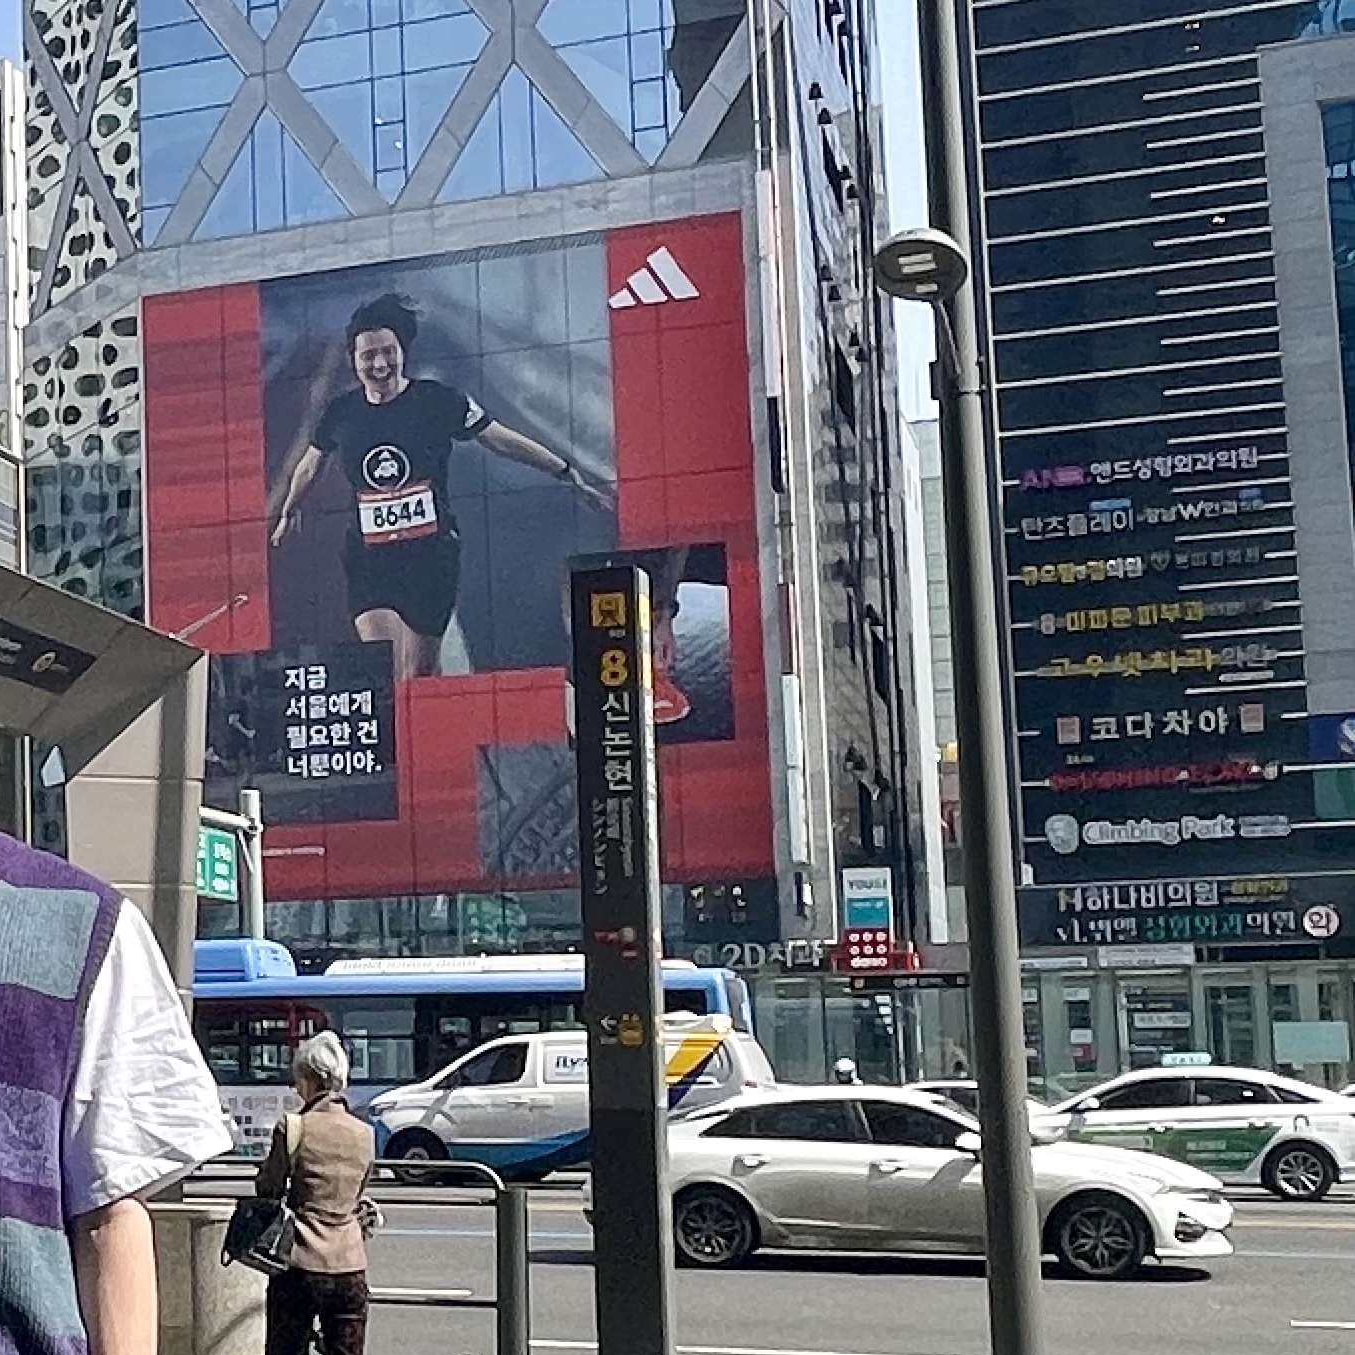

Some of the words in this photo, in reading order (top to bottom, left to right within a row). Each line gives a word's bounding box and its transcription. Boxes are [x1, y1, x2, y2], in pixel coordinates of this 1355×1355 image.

[373, 498, 426, 529] 8644
[284, 665, 328, 691] 지금
[600, 649, 629, 687] 8
[285, 689, 372, 719] 서울에게
[286, 721, 351, 750] 필요한
[356, 719, 378, 745] 건
[1090, 706, 1230, 740] 코다차야
[601, 691, 634, 792] 신논현
[1084, 818, 1180, 845] Climbing
[1181, 814, 1236, 840] Park
